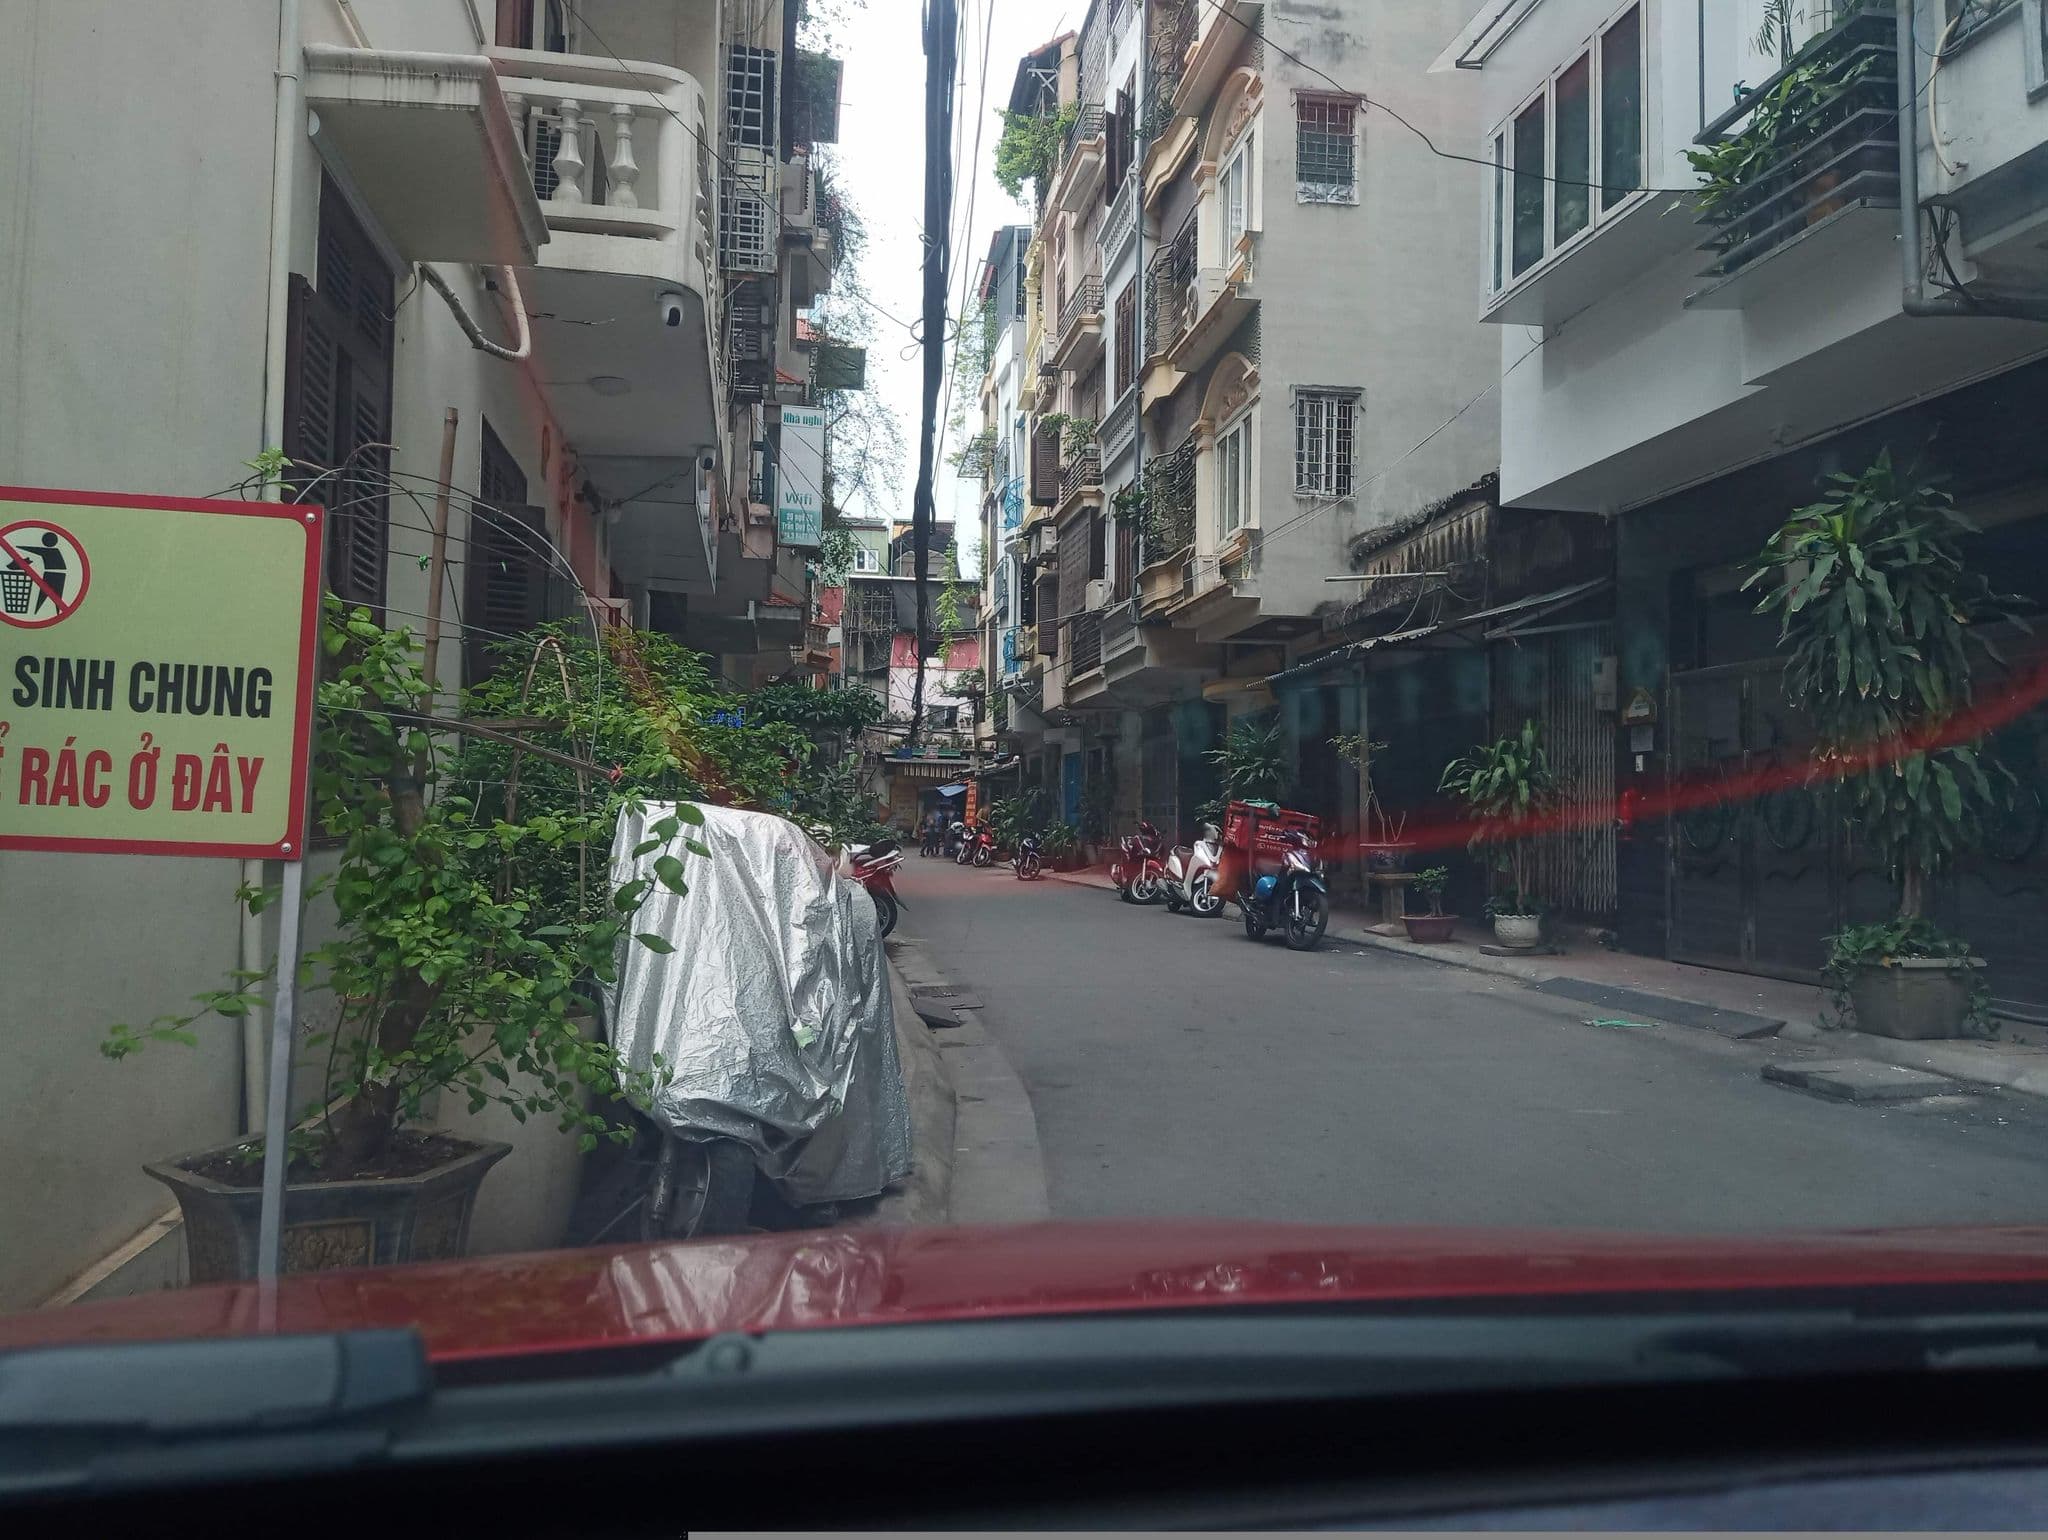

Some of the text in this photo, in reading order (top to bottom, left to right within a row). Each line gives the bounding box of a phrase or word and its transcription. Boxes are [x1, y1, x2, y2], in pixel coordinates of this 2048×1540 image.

[785, 492, 812, 506] Wifi
[12, 655, 273, 718] SINH CHUNG
[18, 736, 112, 809] RÁC
[127, 732, 161, 810] Ở
[171, 742, 264, 814] ĐÂY
